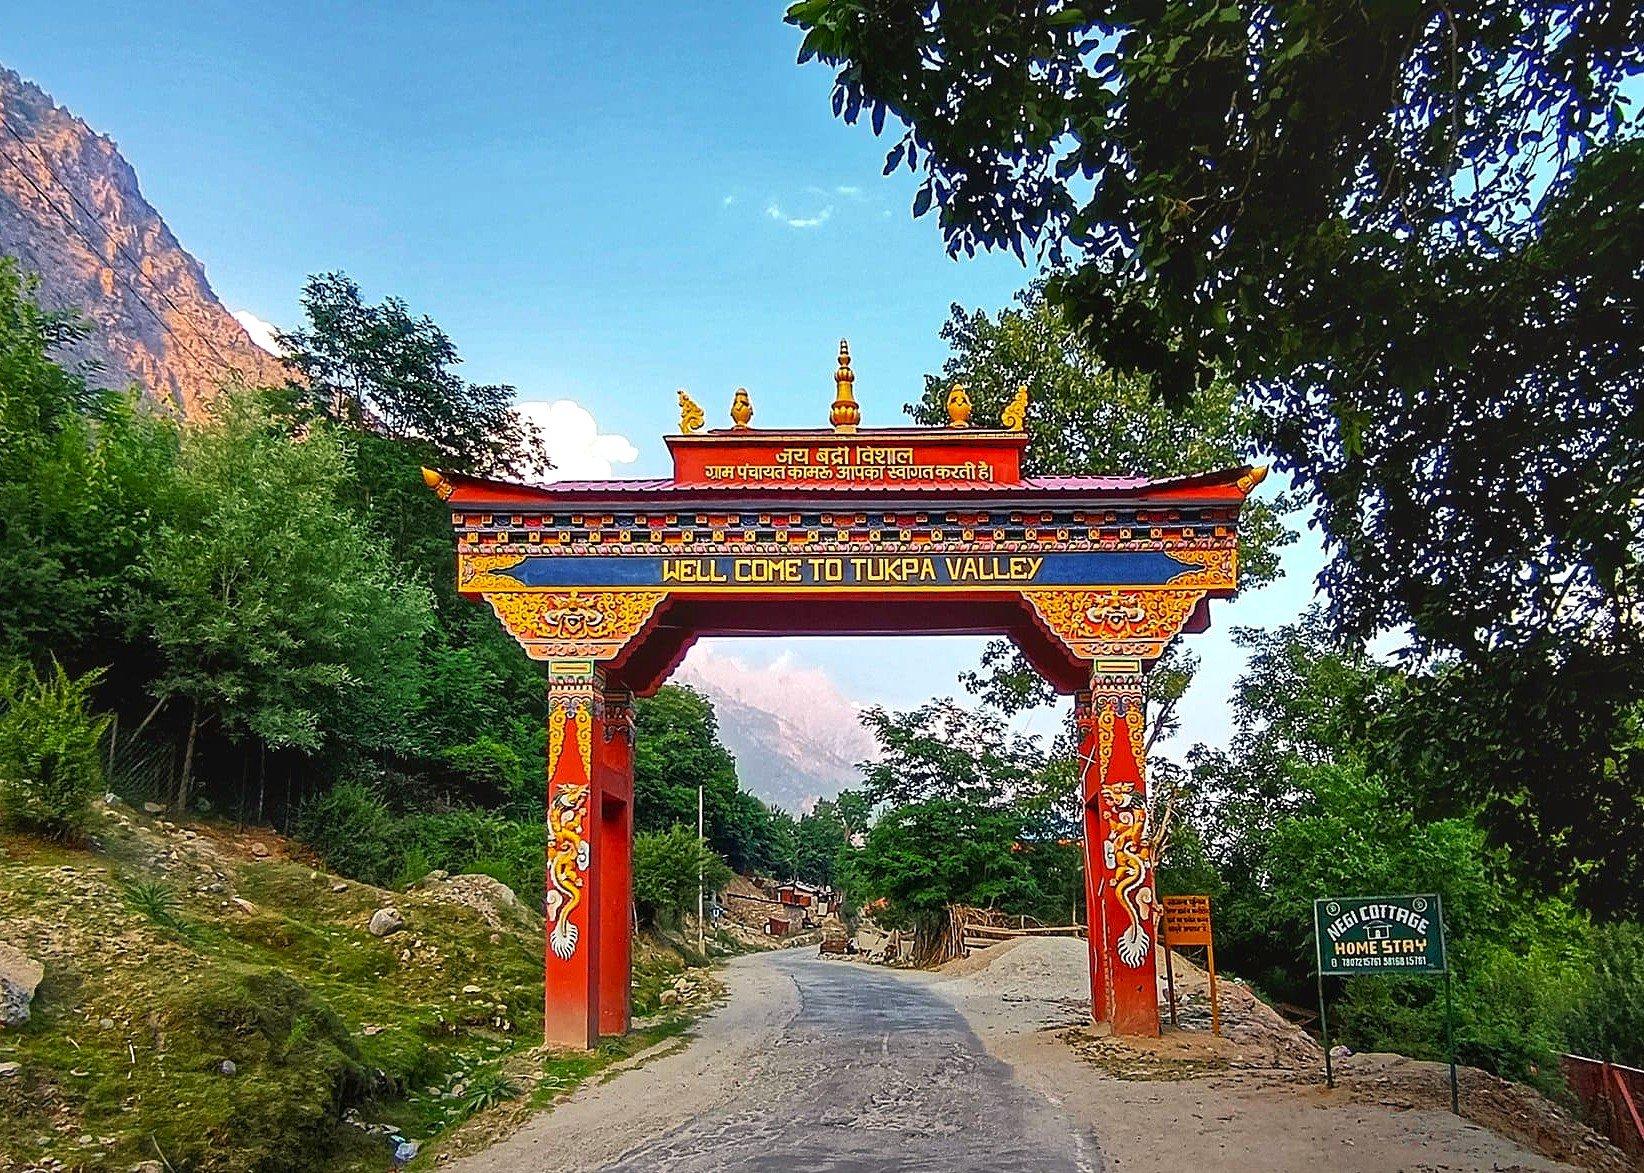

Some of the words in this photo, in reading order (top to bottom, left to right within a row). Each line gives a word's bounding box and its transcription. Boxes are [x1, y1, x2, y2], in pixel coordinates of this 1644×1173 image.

[776, 447, 809, 465] जय
[856, 446, 914, 465] विशाल
[705, 465, 735, 480] ग्राम
[737, 463, 786, 480] पंचायत
[836, 465, 885, 480] आपका
[887, 465, 935, 480] स्वागत
[935, 461, 976, 480] करती
[662, 559, 727, 582] WELL
[734, 559, 802, 582] COME
[809, 559, 843, 581] TO
[851, 558, 936, 581] TUKPA
[945, 557, 1044, 581] VALLEY
[1327, 910, 1359, 941] NEGI
[1359, 904, 1429, 935] COTTAGE
[1335, 941, 1377, 955] HOME
[1381, 938, 1427, 954] STAY
